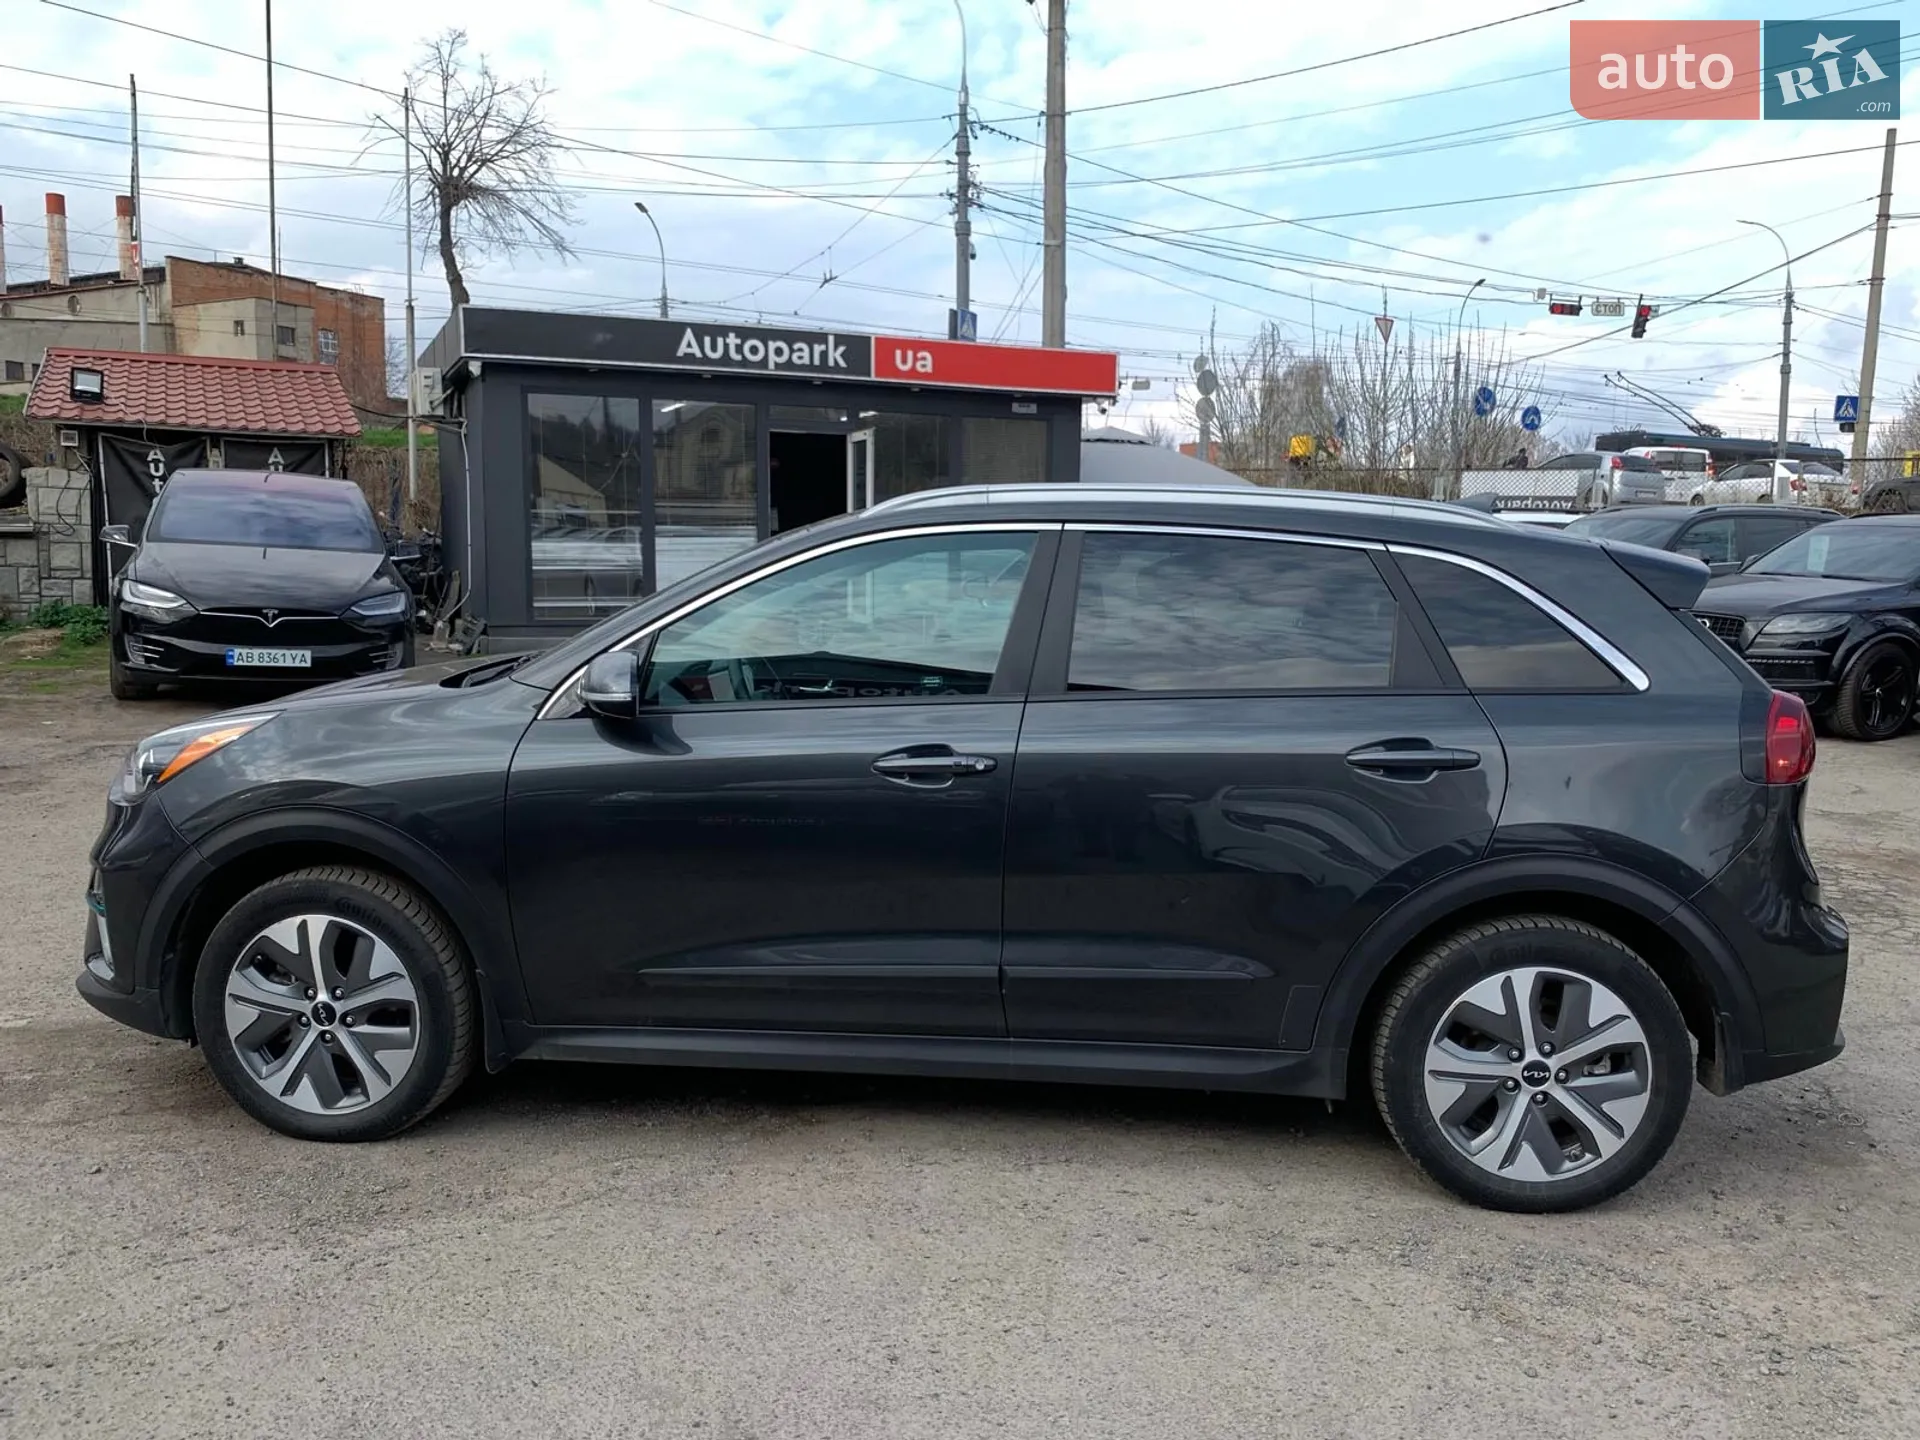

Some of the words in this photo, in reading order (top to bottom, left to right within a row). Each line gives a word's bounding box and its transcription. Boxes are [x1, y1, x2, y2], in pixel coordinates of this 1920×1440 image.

[676, 327, 848, 370] Autopark
[895, 348, 934, 373] ua
[236, 651, 254, 664] AB
[258, 651, 287, 664] 8361
[290, 652, 308, 664] YA
